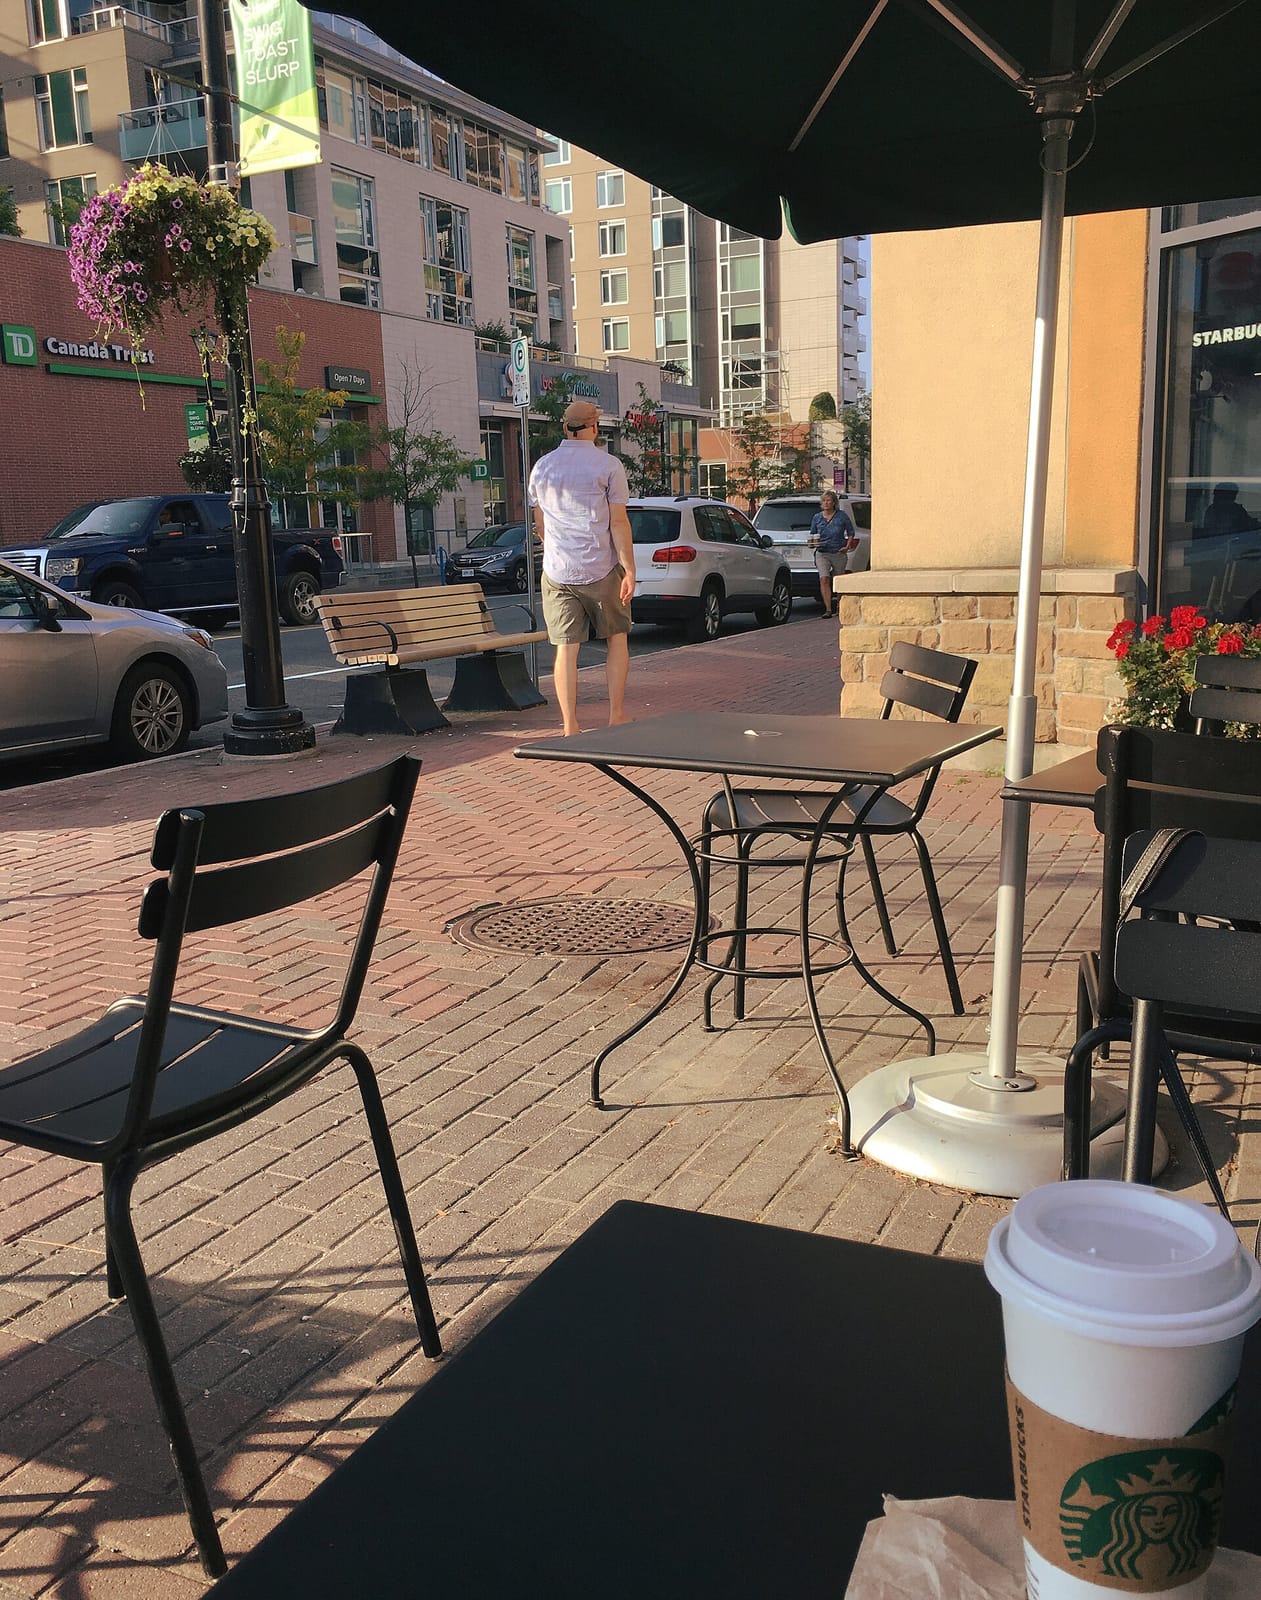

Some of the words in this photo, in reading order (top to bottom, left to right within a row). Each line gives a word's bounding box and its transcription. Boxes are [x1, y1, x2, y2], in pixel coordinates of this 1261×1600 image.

[245, 38, 299, 64] TOAST
[246, 60, 300, 85] SLURP
[6, 332, 34, 358] TD
[46, 337, 109, 360] Canada
[518, 349, 523, 366] P
[334, 373, 349, 383] Open
[352, 375, 366, 386] Days
[1015, 1405, 1032, 1531] STARBUCKS
